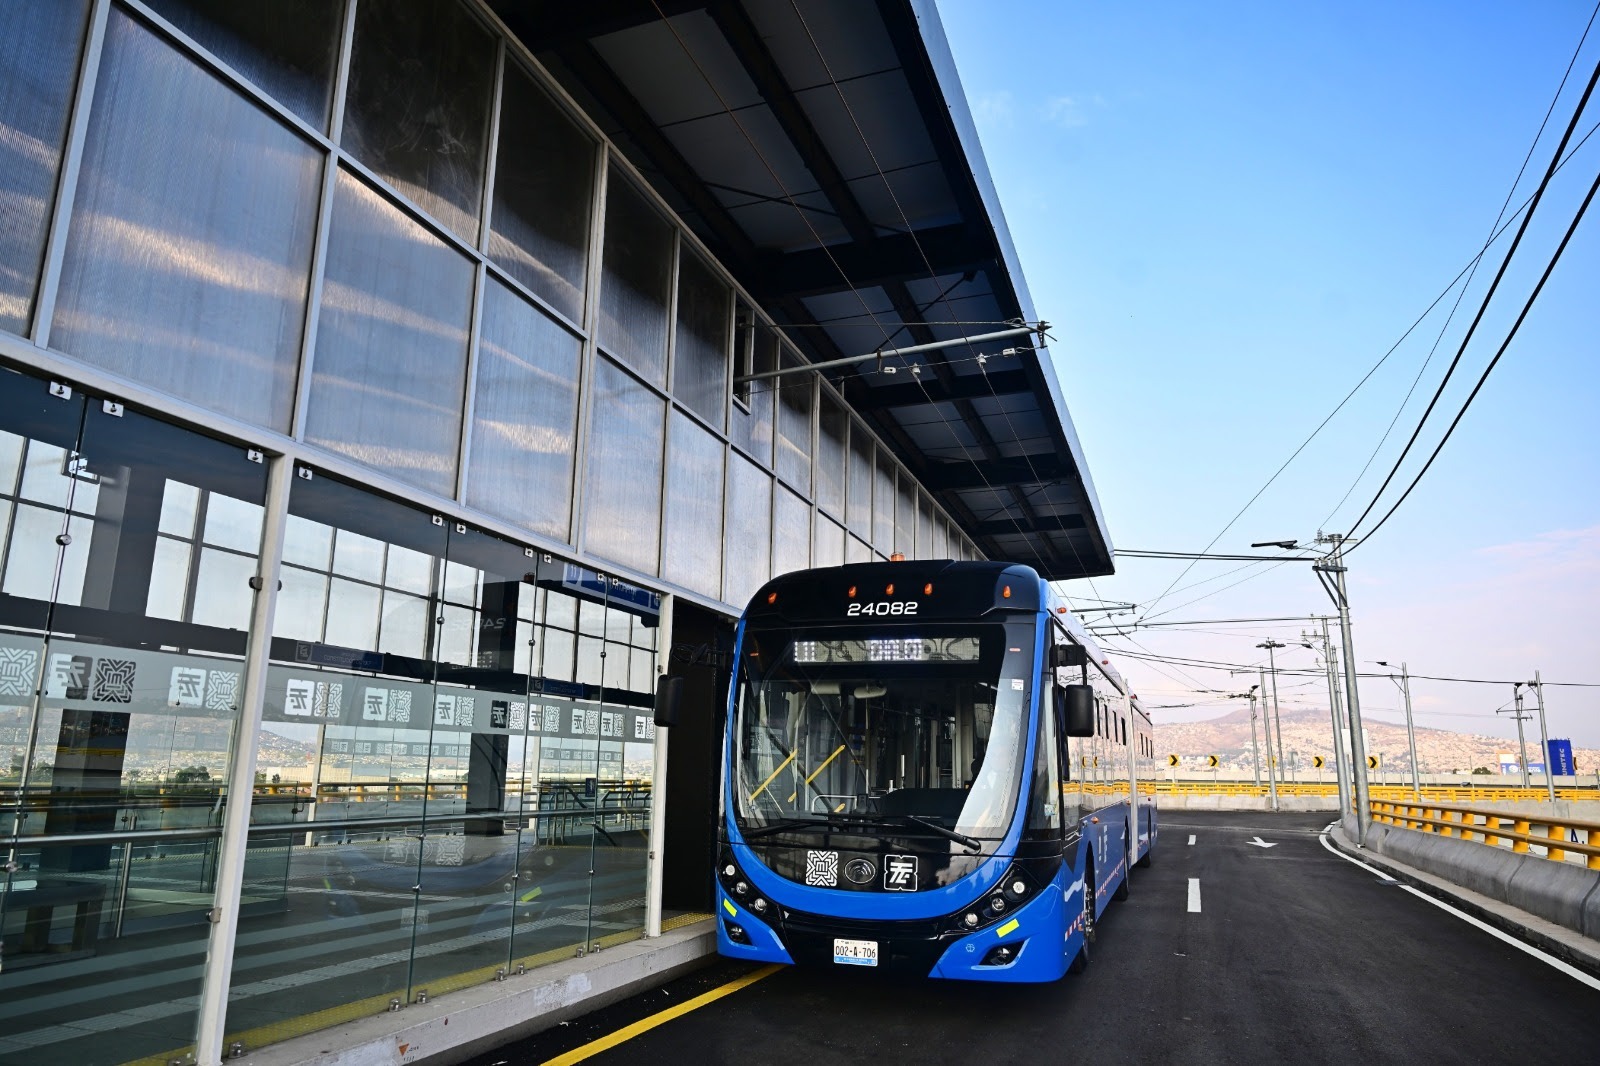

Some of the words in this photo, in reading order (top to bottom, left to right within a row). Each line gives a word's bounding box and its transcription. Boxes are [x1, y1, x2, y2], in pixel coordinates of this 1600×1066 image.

[847, 601, 918, 616] 24082
[1559, 748, 1568, 776] UNITEC
[835, 945, 876, 958] 002-A-706
